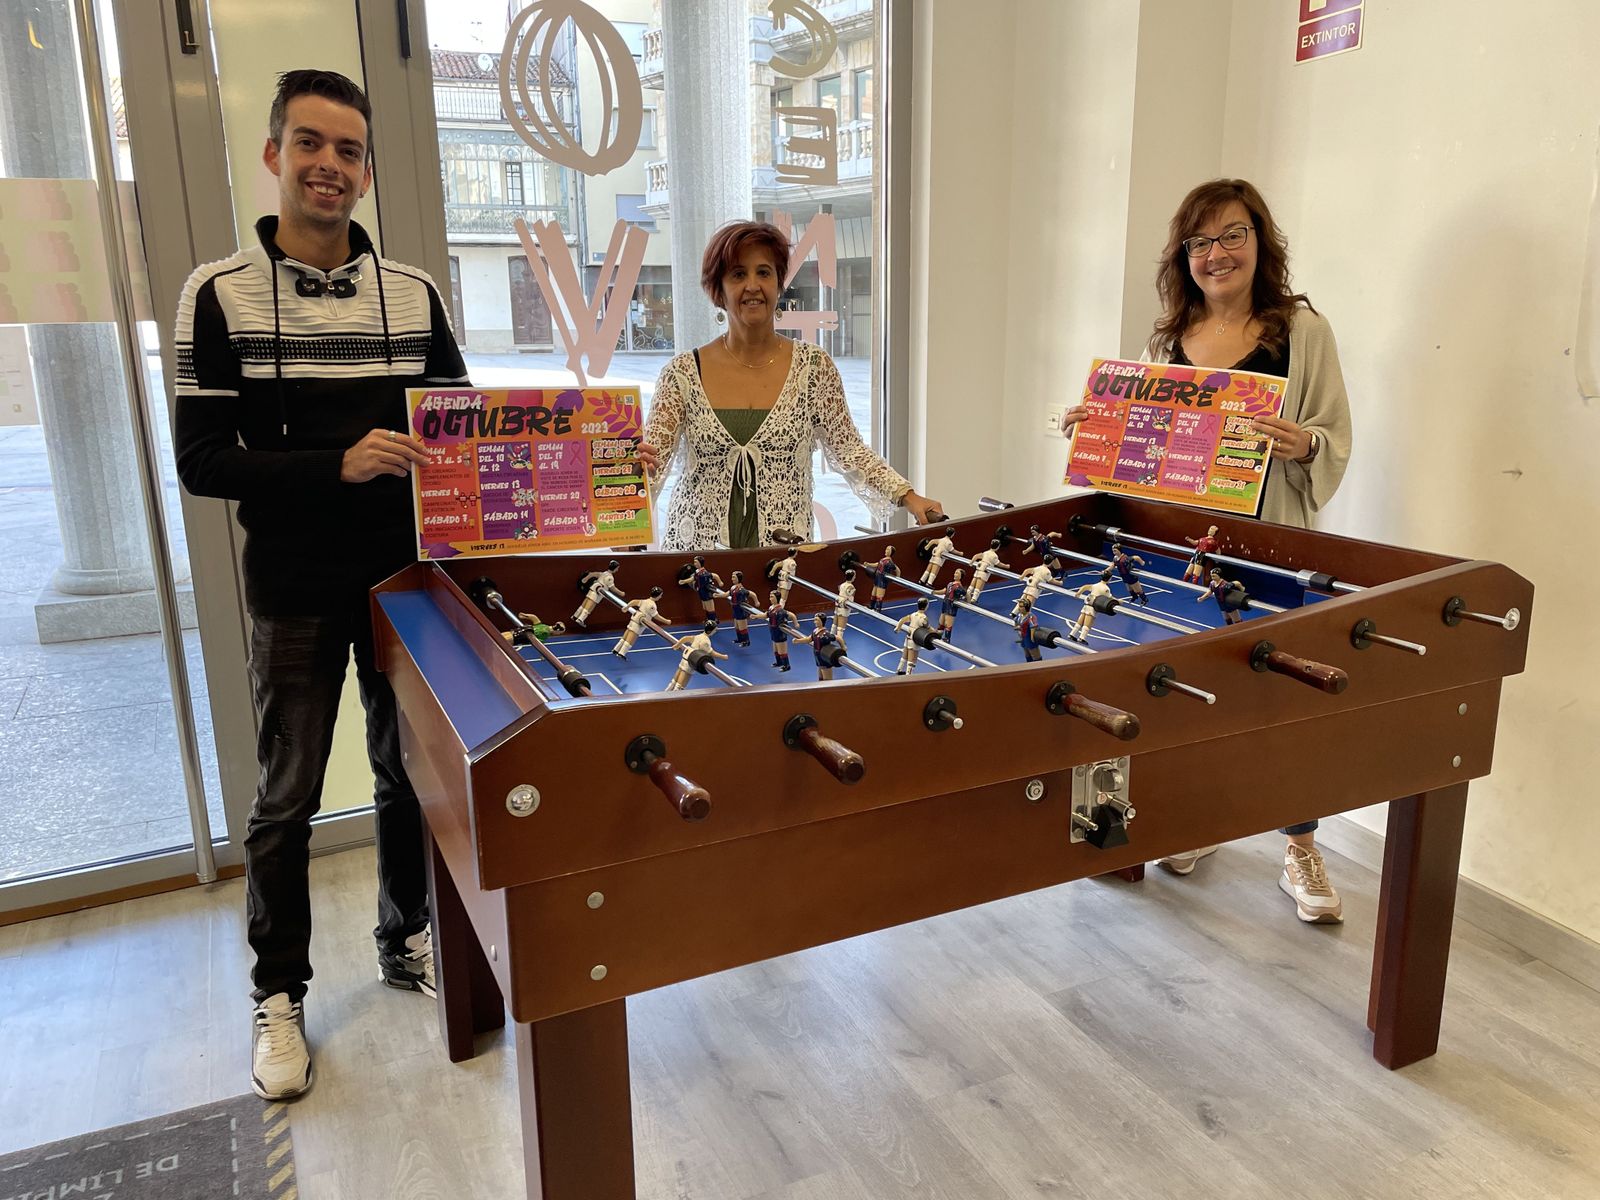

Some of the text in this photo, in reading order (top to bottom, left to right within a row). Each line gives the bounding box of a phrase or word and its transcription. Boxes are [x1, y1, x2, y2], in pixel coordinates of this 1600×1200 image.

[1301, 22, 1356, 49] EXTINTOR
[1098, 363, 1146, 378] AGENDA
[1093, 374, 1218, 407] OCTUBRE
[421, 394, 482, 410] AGENDA
[1220, 400, 1247, 412] 2023
[422, 406, 573, 440] OCTUBRE
[581, 421, 608, 434] 2023
[479, 454, 504, 463] DEL 10
[555, 451, 563, 460] 17
[1073, 451, 1100, 462] SÁBADO
[479, 463, 500, 472] AL 12
[1118, 458, 1146, 468] SÁBADO
[593, 465, 632, 475] VIERNES 27
[1165, 472, 1194, 482] SÁBADO
[480, 480, 520, 490] VIERNES 13
[595, 484, 636, 497] SÁBADO 28
[421, 489, 451, 497] VIERNES
[540, 493, 568, 501] VIERNES
[424, 514, 460, 525] SÁBADO
[484, 510, 529, 521] SÁBADO 14
[544, 516, 577, 526] SÁBADO
[598, 510, 635, 521] MARTES 31
[136, 1154, 179, 1178] DE
